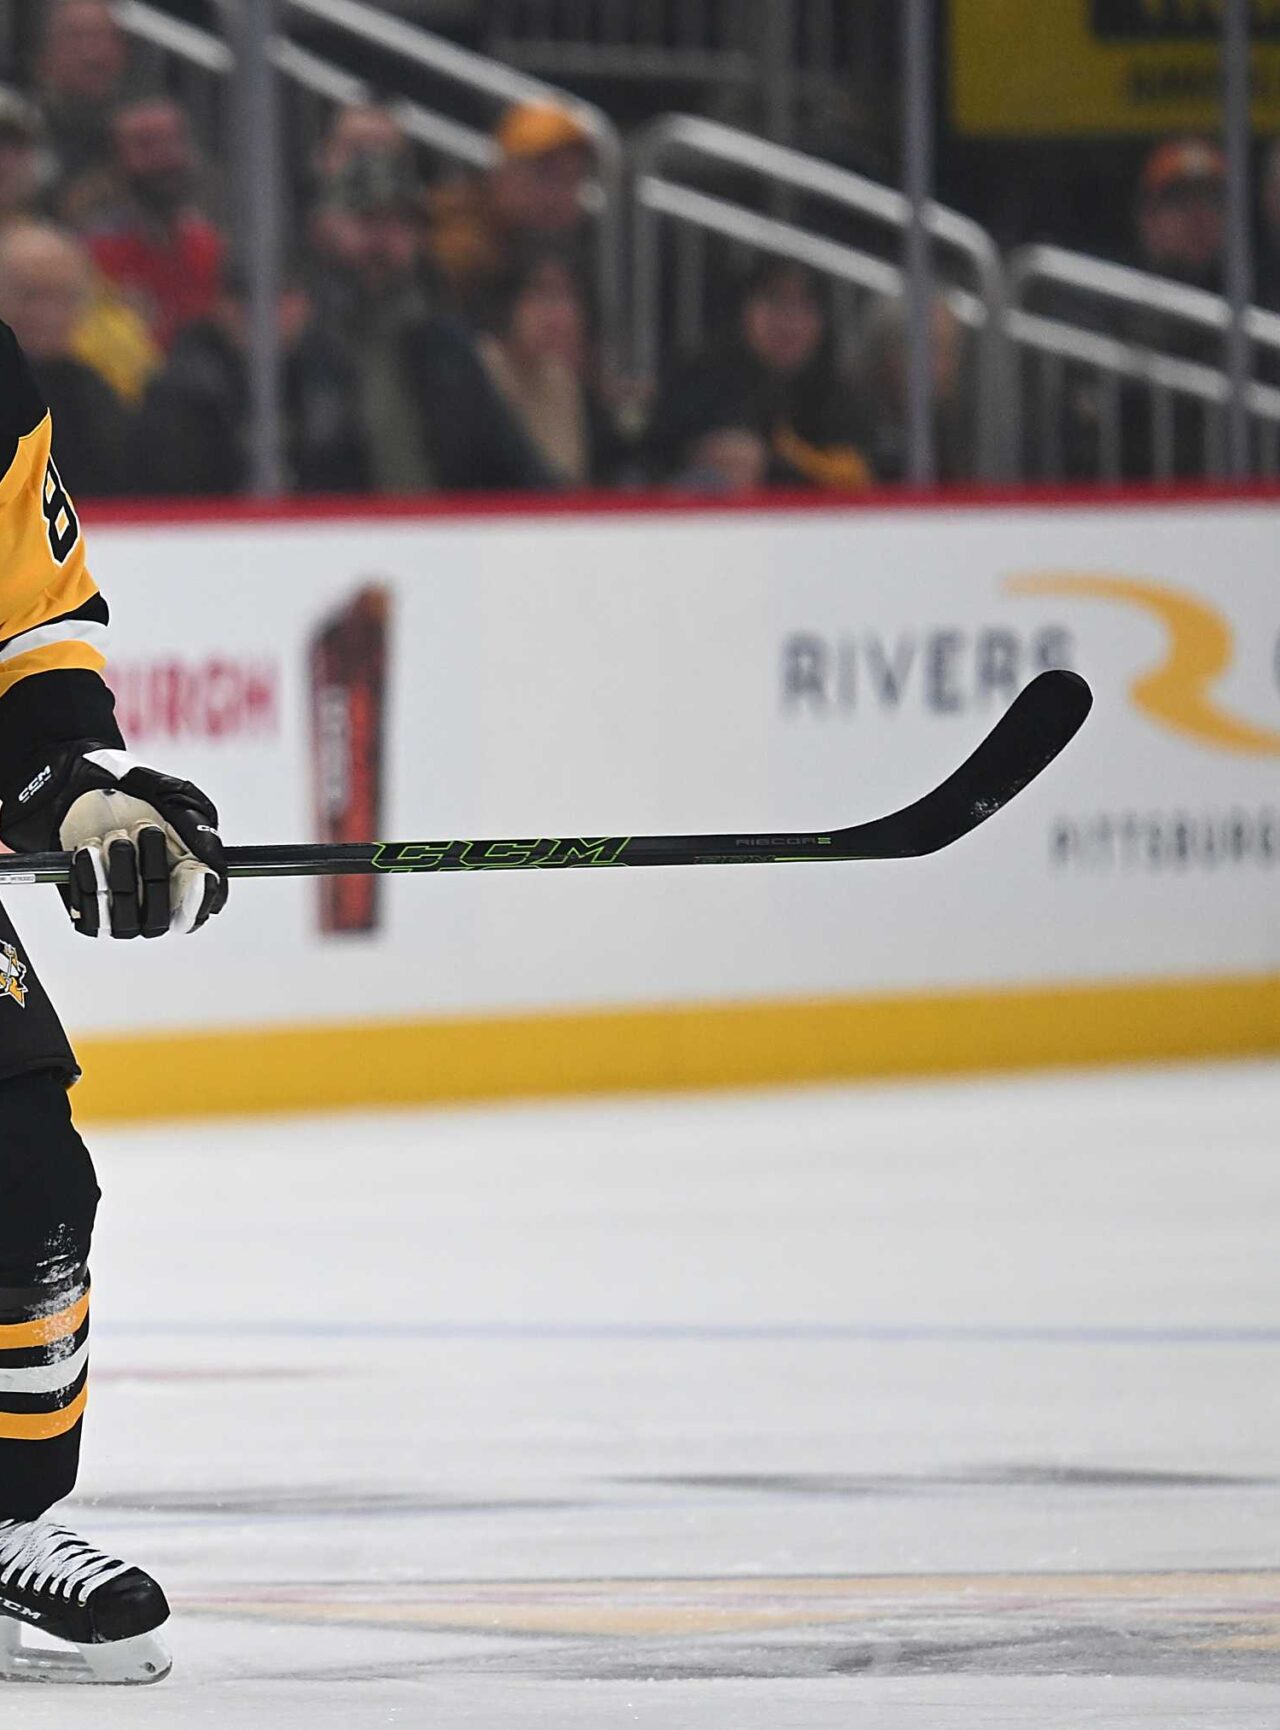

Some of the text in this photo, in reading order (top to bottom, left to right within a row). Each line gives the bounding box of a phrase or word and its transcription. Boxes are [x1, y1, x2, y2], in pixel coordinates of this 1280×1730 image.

[41, 452, 81, 568] 8
[18, 764, 51, 802] CCM
[370, 836, 631, 869] CCM
